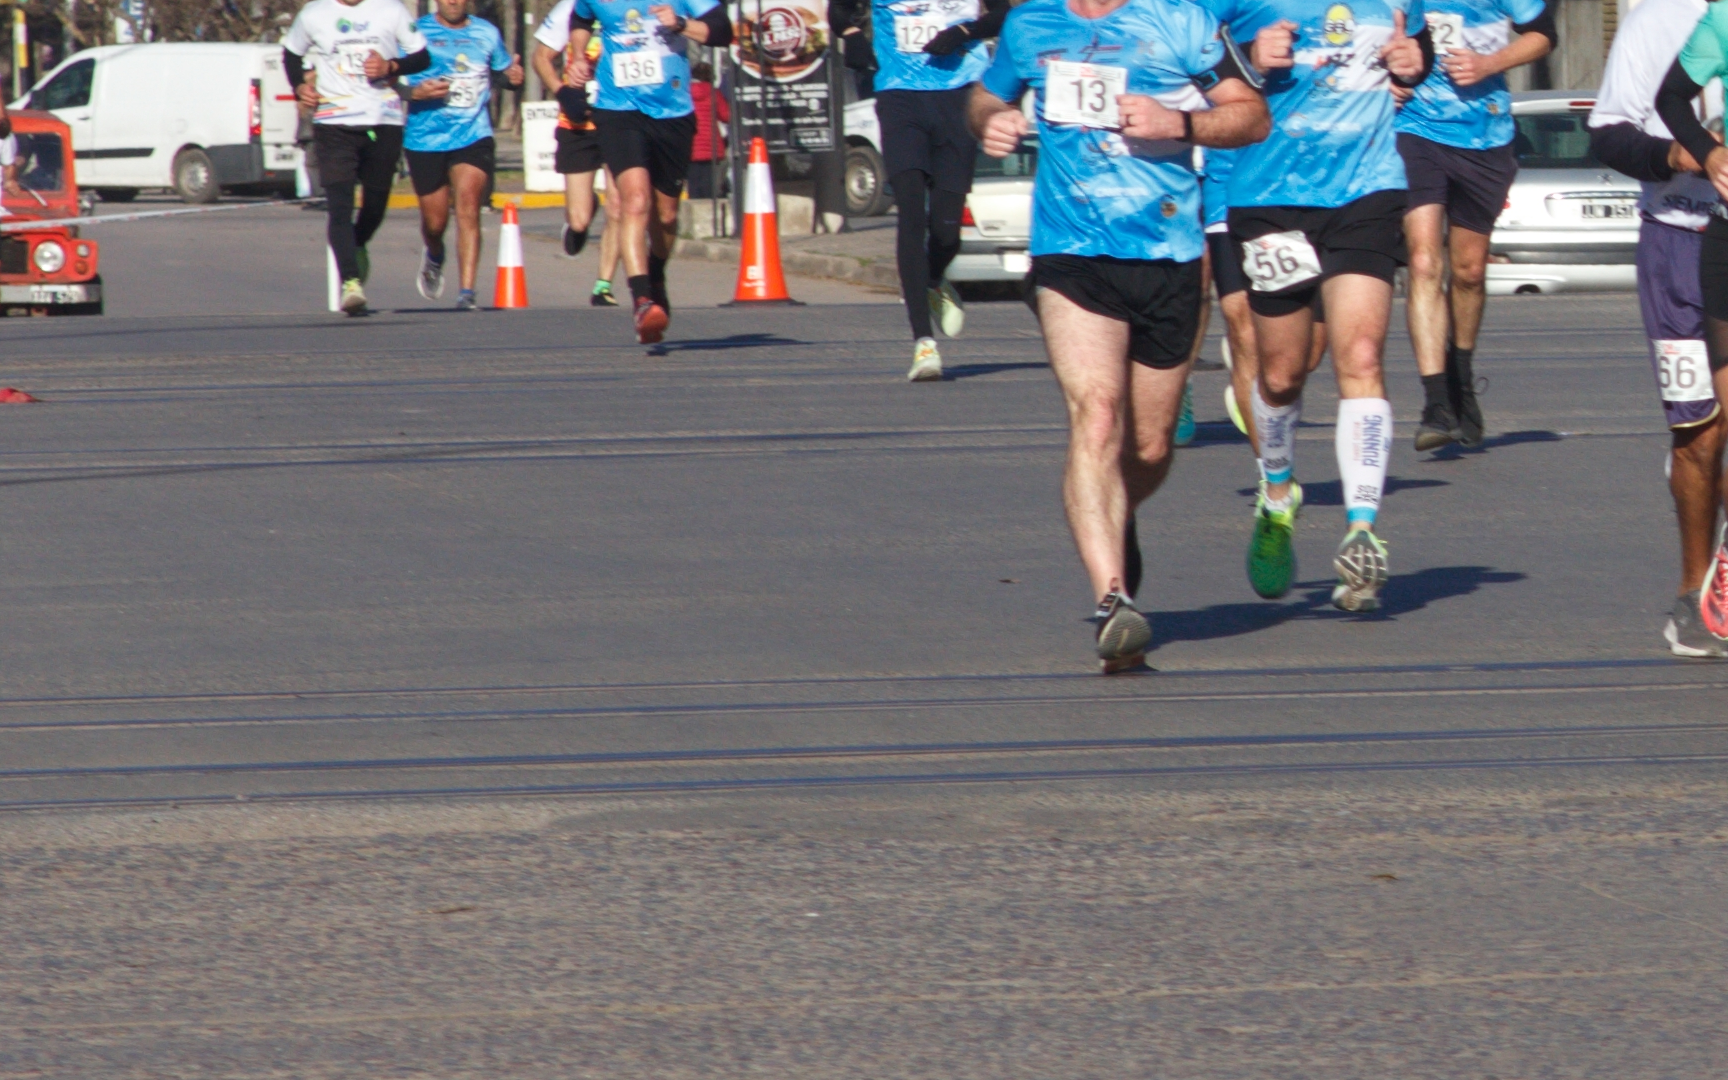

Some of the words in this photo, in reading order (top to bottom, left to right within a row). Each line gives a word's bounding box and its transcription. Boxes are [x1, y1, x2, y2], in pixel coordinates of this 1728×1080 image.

[620, 60, 655, 80] 136
[1070, 79, 1106, 113] 13
[1254, 245, 1300, 281] 56
[1659, 355, 1697, 389] 66
[1361, 414, 1384, 468] RUNNING
